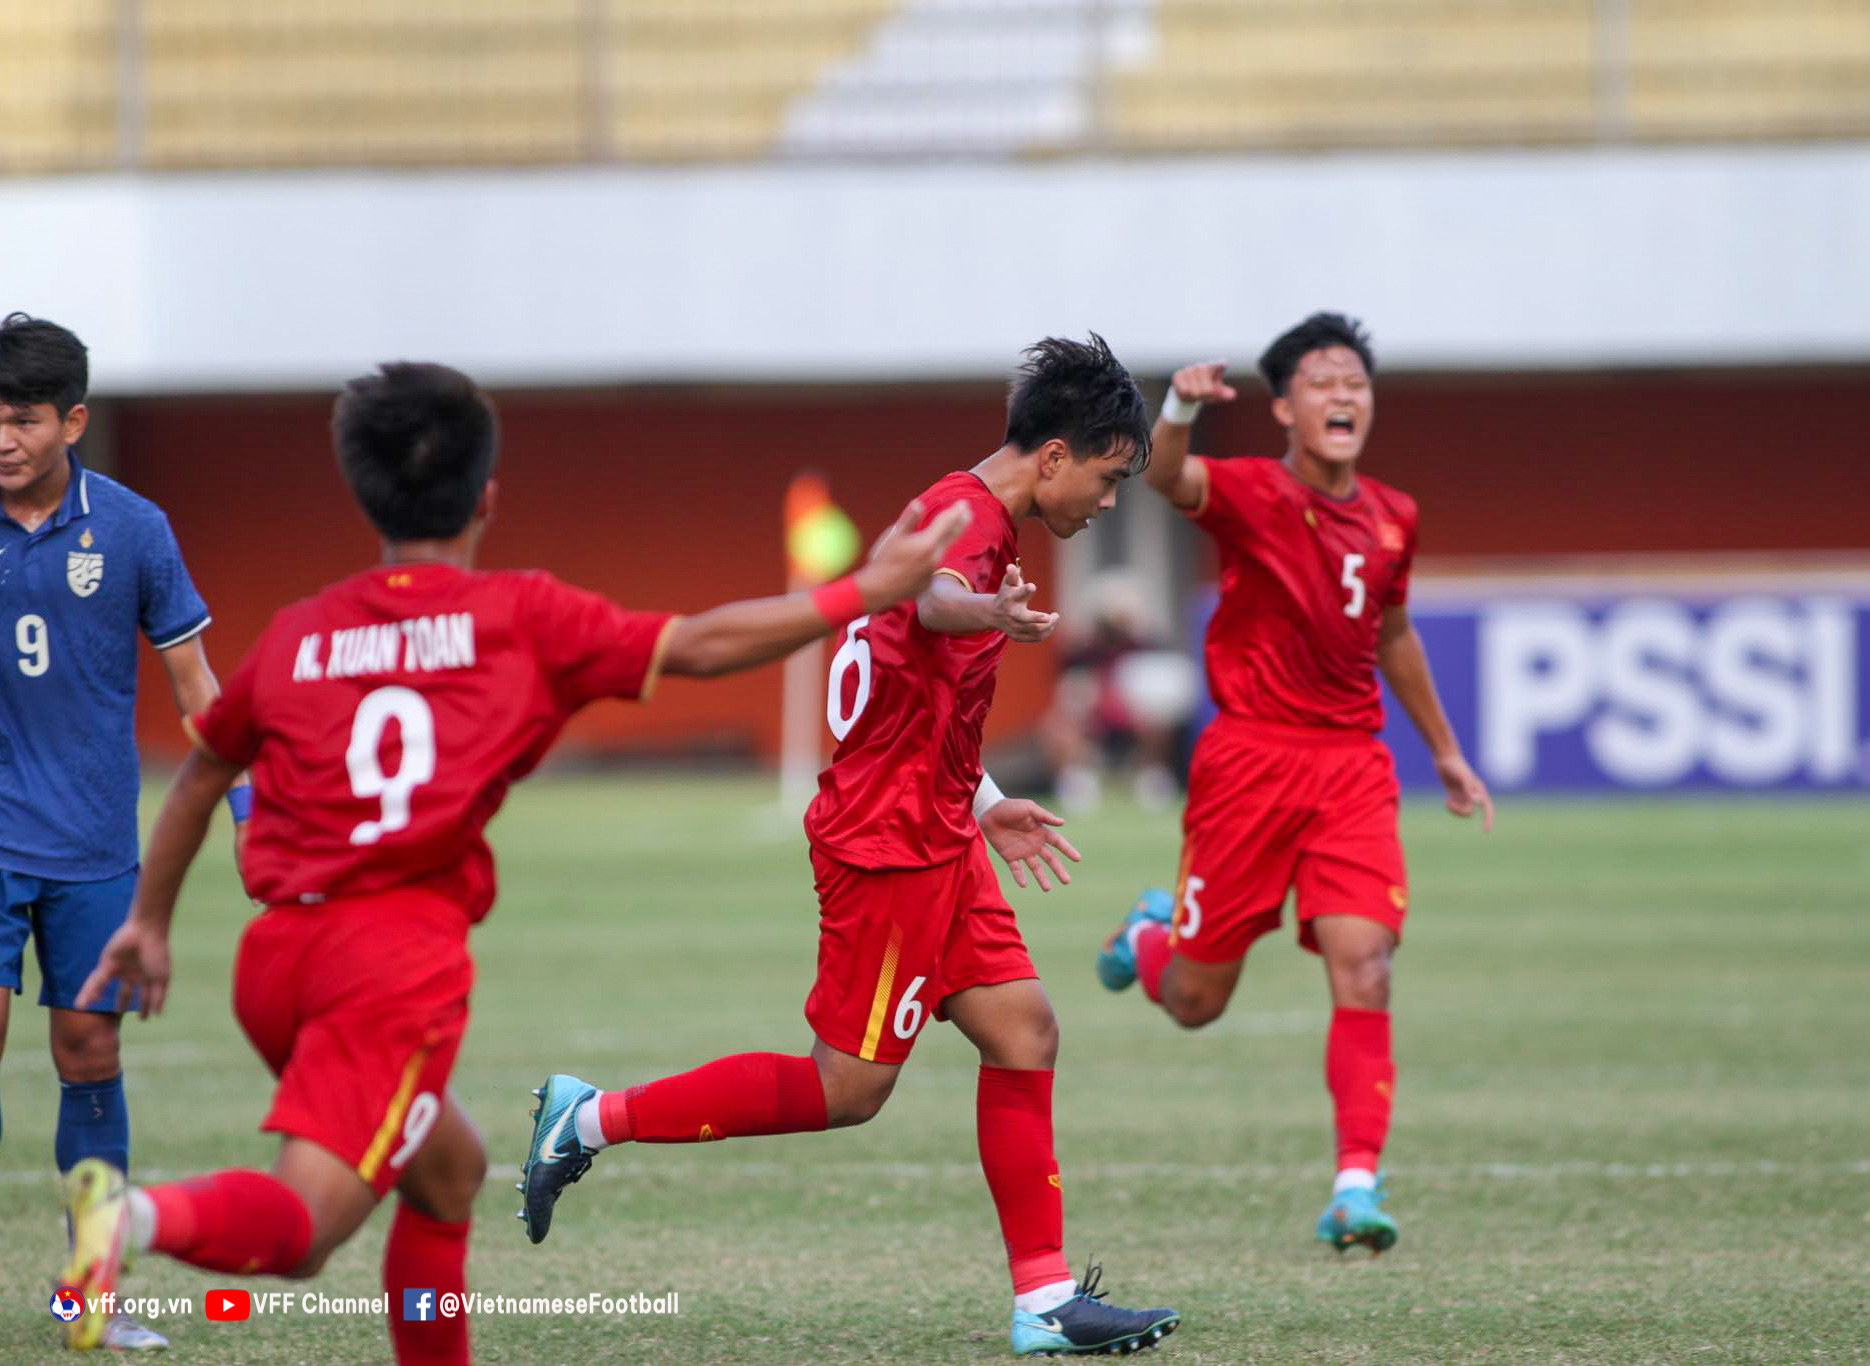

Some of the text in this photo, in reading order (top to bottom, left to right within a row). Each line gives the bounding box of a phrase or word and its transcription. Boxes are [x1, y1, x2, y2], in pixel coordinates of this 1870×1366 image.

[1342, 554, 1365, 618] 5
[15, 614, 49, 677] 9
[326, 622, 398, 679] XUAN
[400, 612, 474, 672] TOAN
[827, 615, 871, 742] 6
[1478, 599, 1857, 785] PSSI
[346, 686, 435, 845] 9
[1179, 876, 1204, 939] 5
[893, 976, 927, 1040] 6
[389, 1092, 438, 1168] 9
